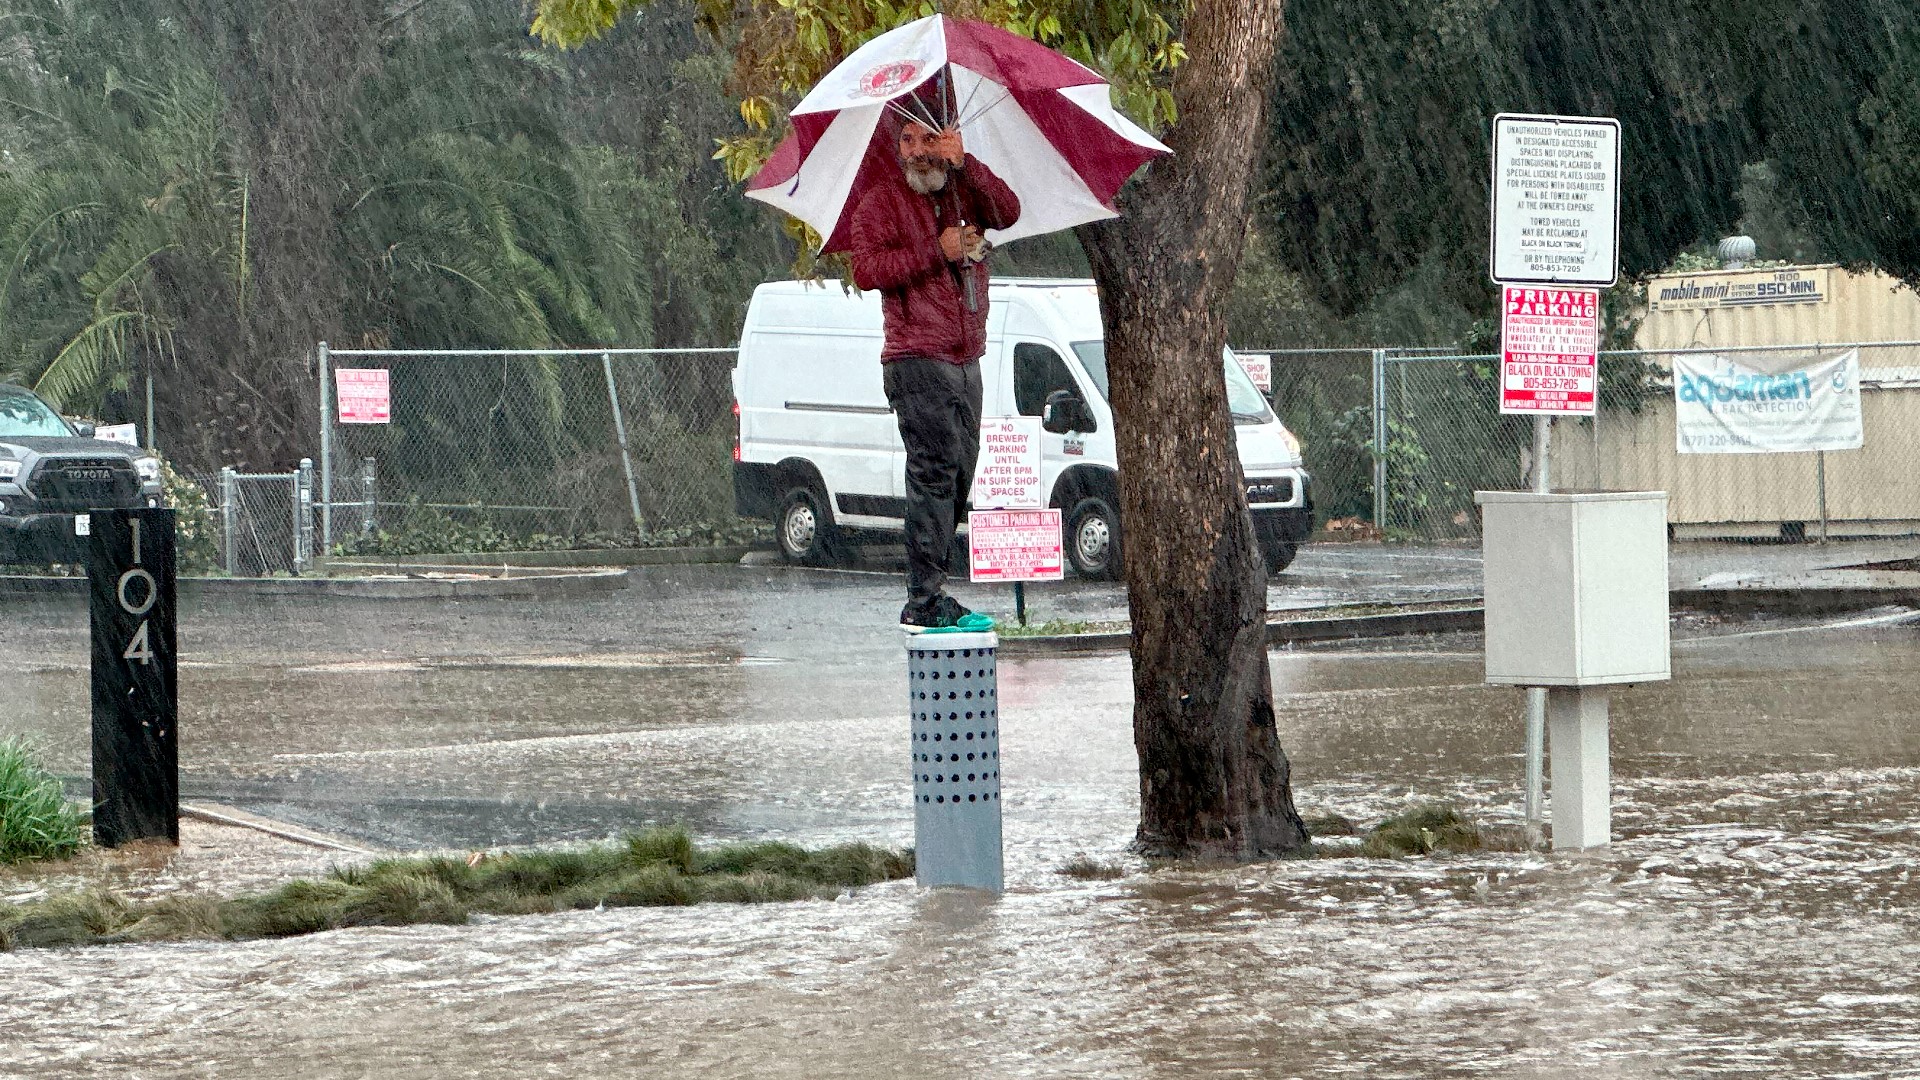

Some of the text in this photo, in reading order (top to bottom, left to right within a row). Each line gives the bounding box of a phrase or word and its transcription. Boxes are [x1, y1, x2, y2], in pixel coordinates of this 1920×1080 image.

[1507, 126, 1606, 138] UNAUTHORIZED VEHICLES PARKED
[1524, 138, 1560, 146] DESIGNATED
[1562, 140, 1597, 148] ACCESSIBLE
[1558, 150, 1593, 158] DISPLAYING
[1511, 158, 1558, 168] DISTINGUISHING
[1560, 160, 1591, 168] PLACARDS
[1507, 169, 1531, 177] SPECIAL
[1533, 170, 1558, 178] LICENSE
[1584, 172, 1605, 180] ISSUED
[1521, 180, 1548, 189] PERSONS
[1566, 182, 1604, 191] DISABILITIES
[1526, 202, 1537, 210] THE
[1539, 203, 1565, 211] OWNER'S
[1567, 203, 1594, 212] EXPENSE
[1531, 218, 1580, 227] TOWED VEHICLES
[1546, 229, 1579, 238] RECLAIMED
[1544, 255, 1584, 264] TELEPHONING
[1661, 280, 1730, 300] mobile mini
[1511, 290, 1593, 305] PRIVATE
[1508, 302, 1594, 317] PARKING
[1247, 364, 1265, 372] SHOP
[1509, 365, 1591, 378] BLACK ON BLACK TOWING
[1524, 378, 1578, 389] 805-853-7205
[1748, 400, 1812, 413] DETECTION
[1001, 424, 1013, 432] NO
[988, 445, 1027, 453] PARKING
[67, 470, 111, 478] TOYOTA
[989, 477, 1012, 485] SURF
[1015, 477, 1038, 485] SHOP
[972, 512, 1058, 527] CUSTOMER PARKING ONLY
[117, 518, 157, 665] 104
